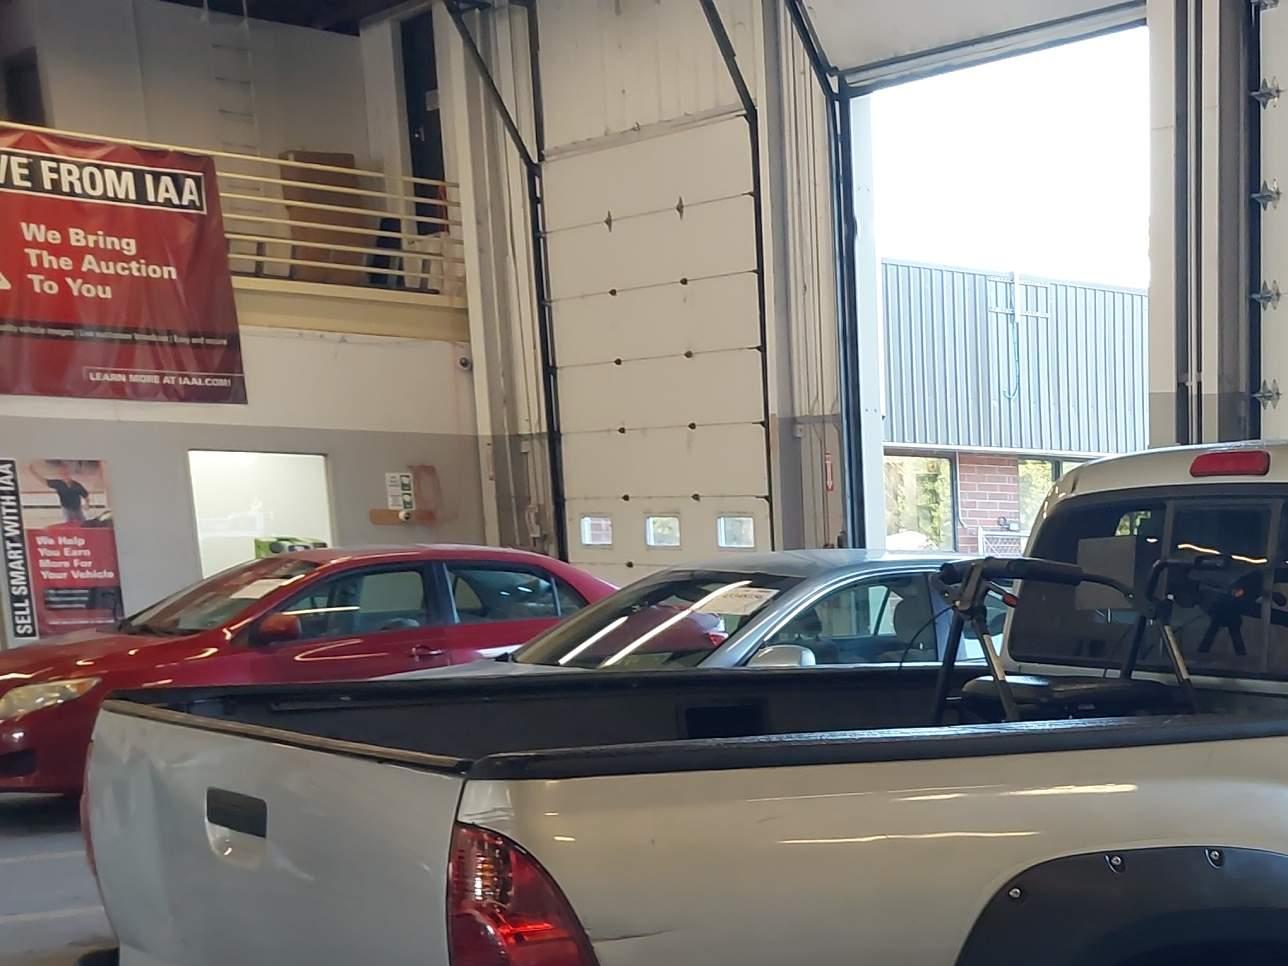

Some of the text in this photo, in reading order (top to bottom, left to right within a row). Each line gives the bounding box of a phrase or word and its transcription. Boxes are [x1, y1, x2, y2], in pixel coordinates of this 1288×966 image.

[40, 160, 136, 201] FROM
[144, 174, 201, 207] IAA
[20, 222, 137, 255] We Bring
[24, 248, 177, 280] The Auction
[27, 274, 113, 299] To You
[89, 372, 126, 383] LEARN
[129, 374, 160, 384] MORE
[162, 376, 176, 385] AT
[0, 463, 33, 634] SELL SMART WITH IAA
[35, 536, 86, 547] We Help
[38, 547, 91, 557] You Earn
[39, 558, 92, 568] More For
[40, 569, 114, 579] Your Vehicle
